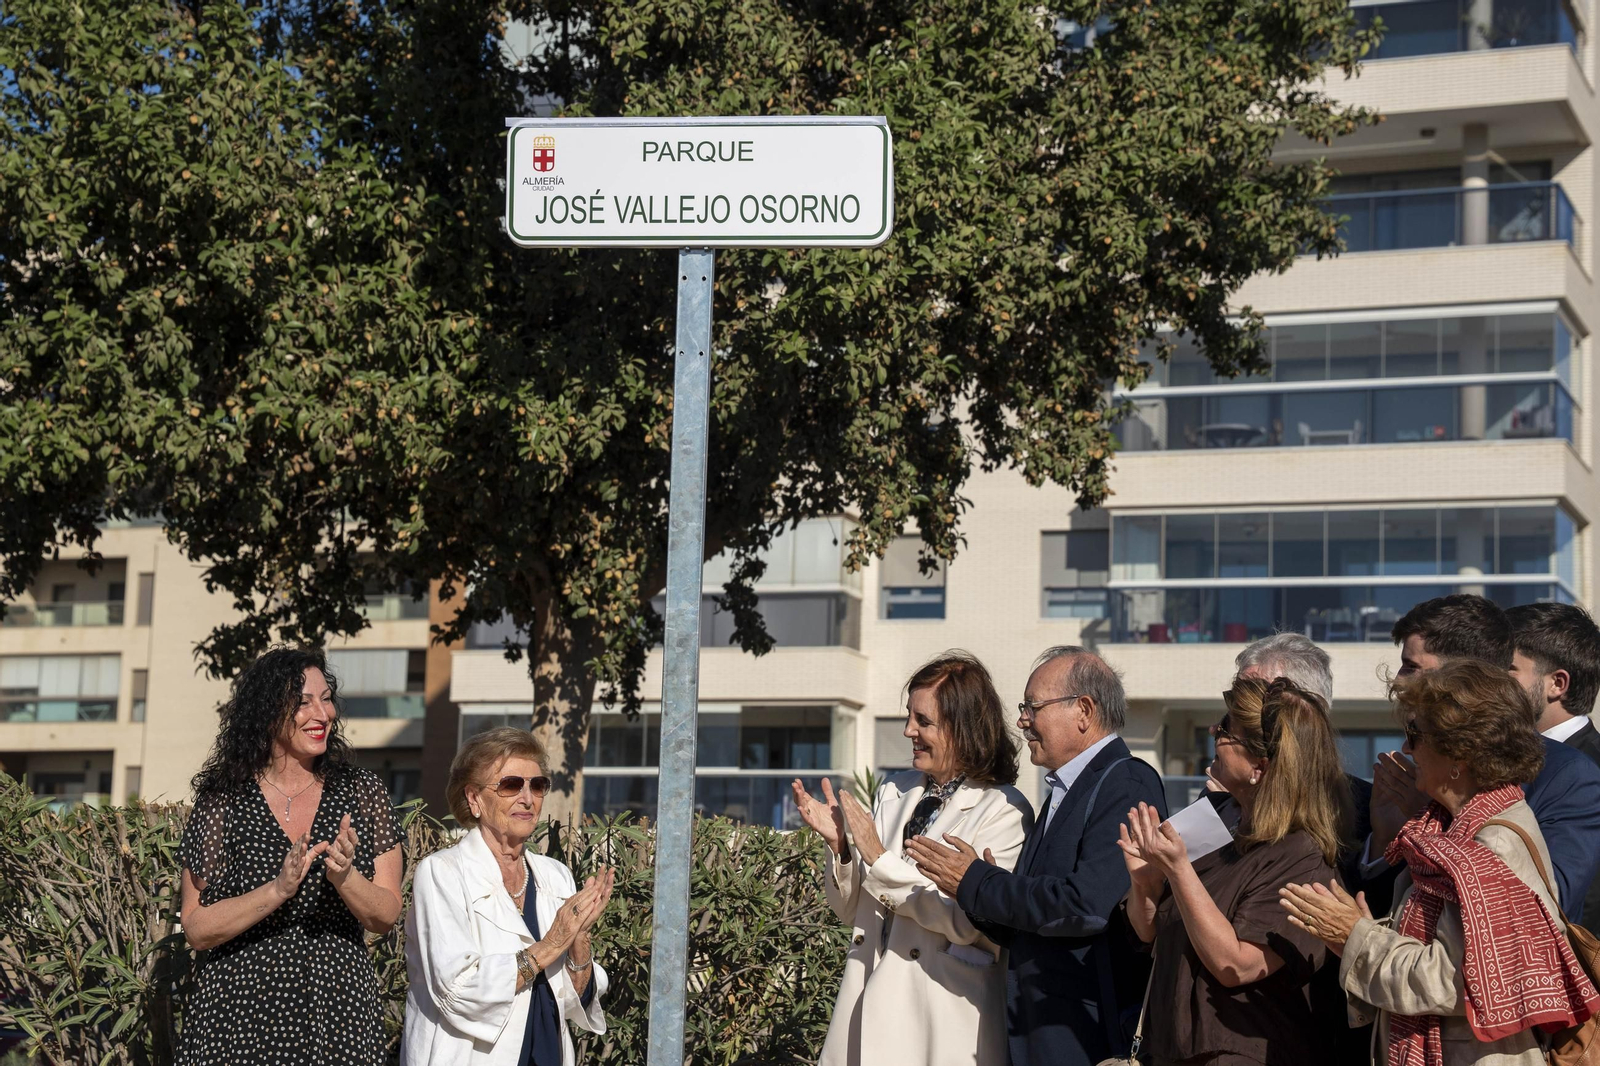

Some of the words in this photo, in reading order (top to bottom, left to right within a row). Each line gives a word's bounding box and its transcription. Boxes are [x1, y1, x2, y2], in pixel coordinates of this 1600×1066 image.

[642, 141, 754, 163] PARQUE
[522, 175, 565, 185] ALMERÍA
[535, 189, 605, 225] JOSÉ
[613, 194, 731, 225] VALLEJO
[739, 193, 861, 224] OSORNO
